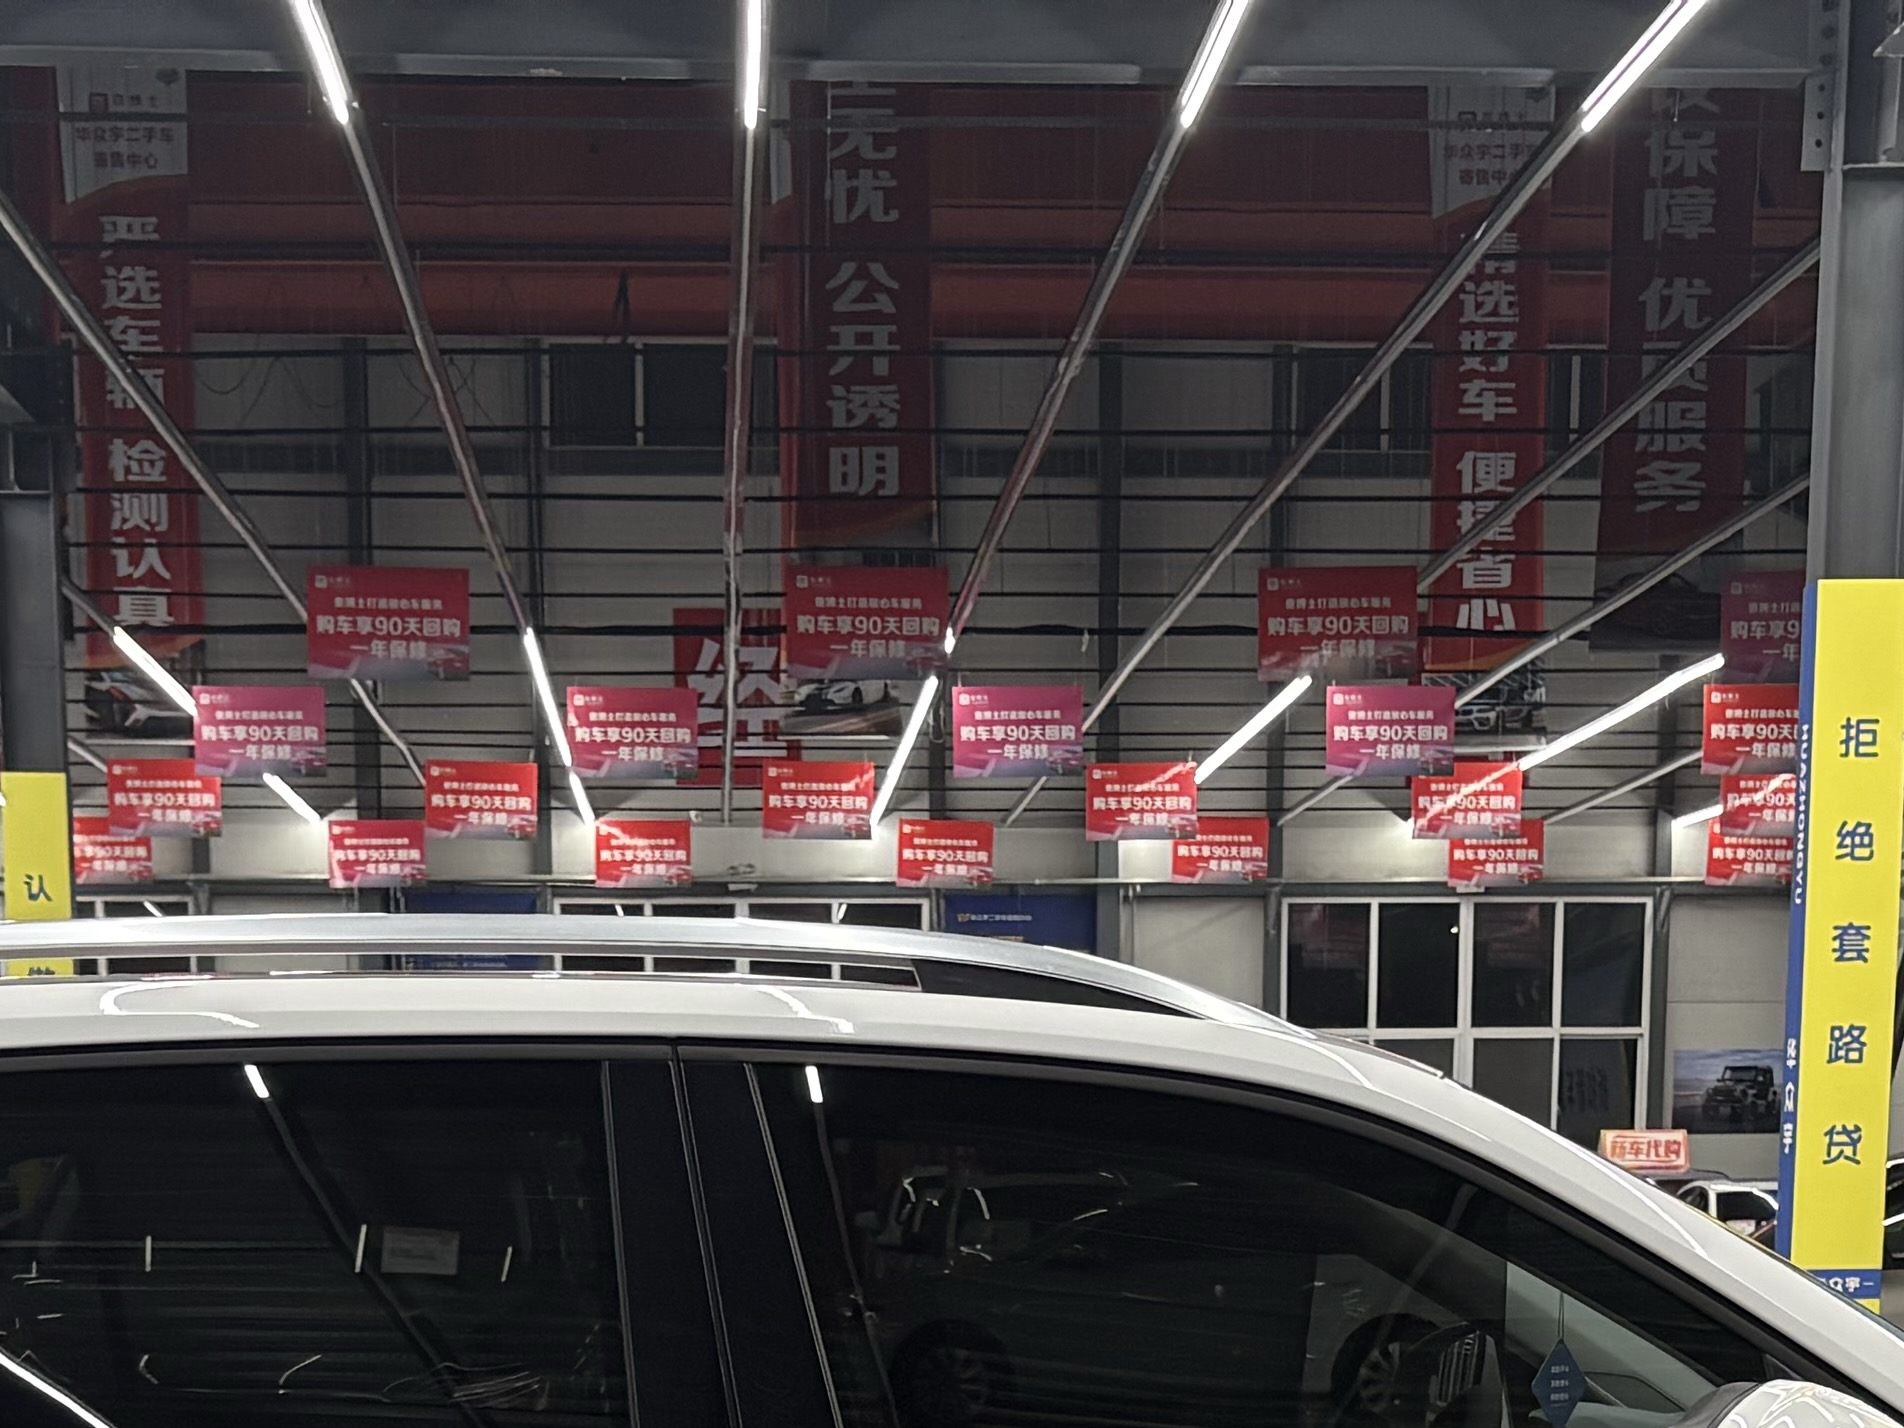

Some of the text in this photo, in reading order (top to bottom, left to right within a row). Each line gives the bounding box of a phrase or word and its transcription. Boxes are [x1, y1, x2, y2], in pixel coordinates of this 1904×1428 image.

[316, 615, 461, 636] 购车享90天回购
[797, 615, 940, 636] 购车享90天回购
[1267, 615, 1409, 636] 购车享90天回购
[350, 640, 428, 659] 一年保修
[830, 639, 906, 658] 一年保修
[1300, 639, 1375, 658] 一年保修
[201, 726, 319, 741] 购车享90天回购
[575, 727, 691, 743] 购车享90天回购
[960, 725, 1075, 741] 购车享90天回购
[1333, 725, 1448, 741] 购车享90天回购
[1710, 723, 1799, 740] 购车享90天
[987, 744, 1048, 760] 一年保修
[1360, 744, 1421, 760] 一年保修
[1822, 716, 1881, 1166] 拒绝套路贷
[1609, 1138, 1683, 1162] 新车代购
[1819, 1275, 1863, 1293] 众宇
